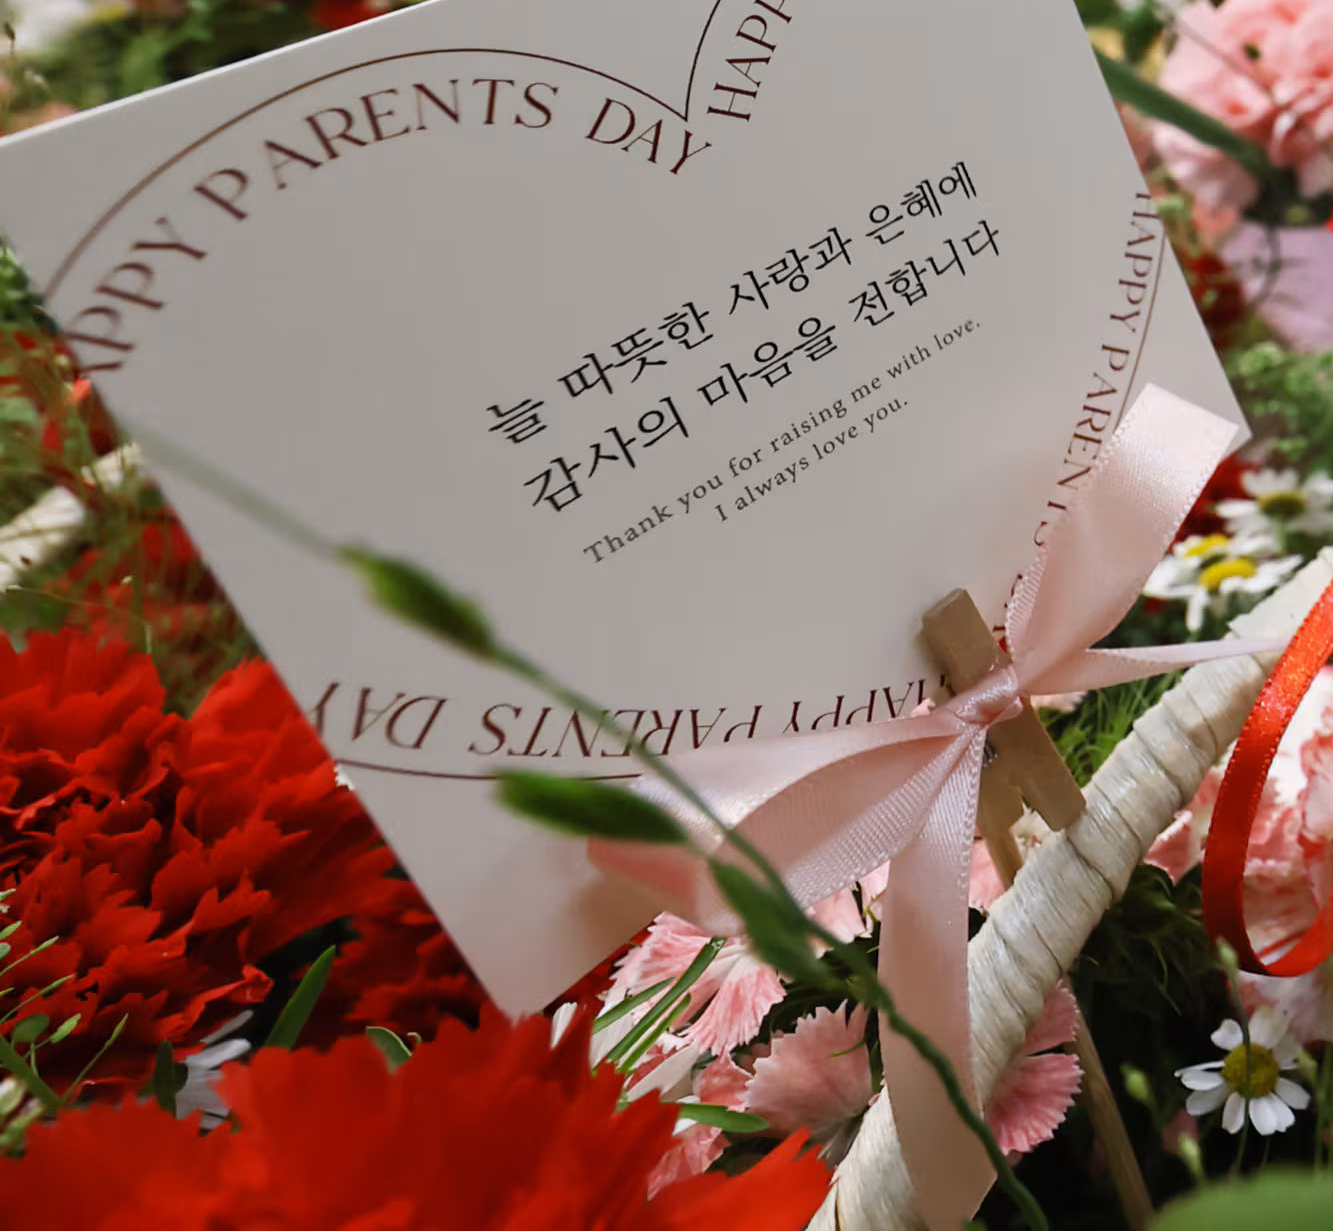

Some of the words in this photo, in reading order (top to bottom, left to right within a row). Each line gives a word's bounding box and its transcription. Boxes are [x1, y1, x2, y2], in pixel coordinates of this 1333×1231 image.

[193, 77, 560, 221] PARENTS
[584, 97, 713, 176] DAY
[485, 398, 549, 445] 늘
[556, 301, 715, 398] 따뜻한
[727, 226, 853, 317] 사랑과
[864, 160, 978, 246] 은혜에
[1109, 191, 1163, 334] HAPPY
[522, 395, 690, 513] 감사의
[696, 316, 839, 407] 마음을
[847, 219, 1001, 327] 전합니다
[582, 503, 675, 565] Thank
[676, 477, 724, 514] you
[727, 448, 765, 480] for
[769, 398, 849, 453] raising
[850, 377, 883, 404] me
[886, 344, 933, 382] with
[932, 318, 982, 352] love.
[712, 503, 730, 524] I
[733, 456, 811, 512] always
[811, 424, 860, 461] love
[863, 399, 910, 434] you.
[467, 702, 763, 758] PARENTS
